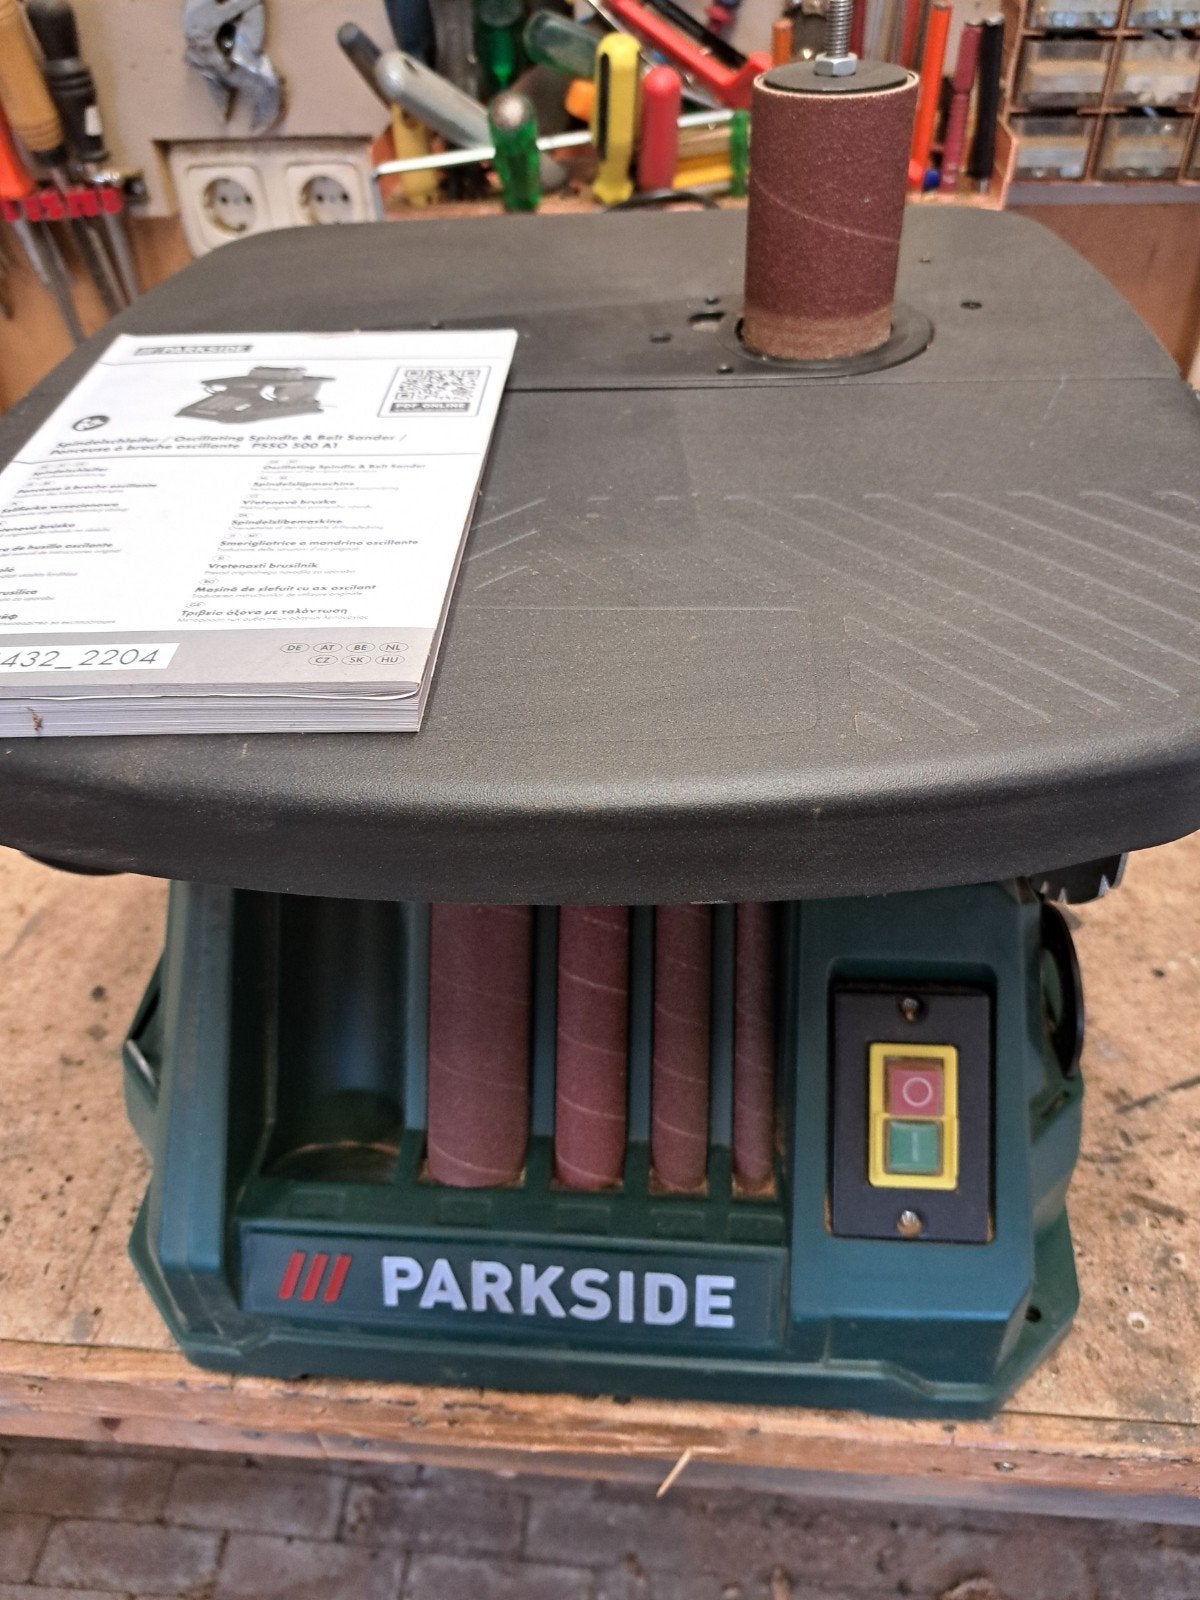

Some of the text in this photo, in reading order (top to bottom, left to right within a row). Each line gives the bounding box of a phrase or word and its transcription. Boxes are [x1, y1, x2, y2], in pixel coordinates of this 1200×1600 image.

[162, 346, 248, 354] PARKSIDE
[248, 434, 299, 442] Spindle
[347, 433, 395, 441] Sander
[381, 1256, 735, 1329] PARKSIDE
